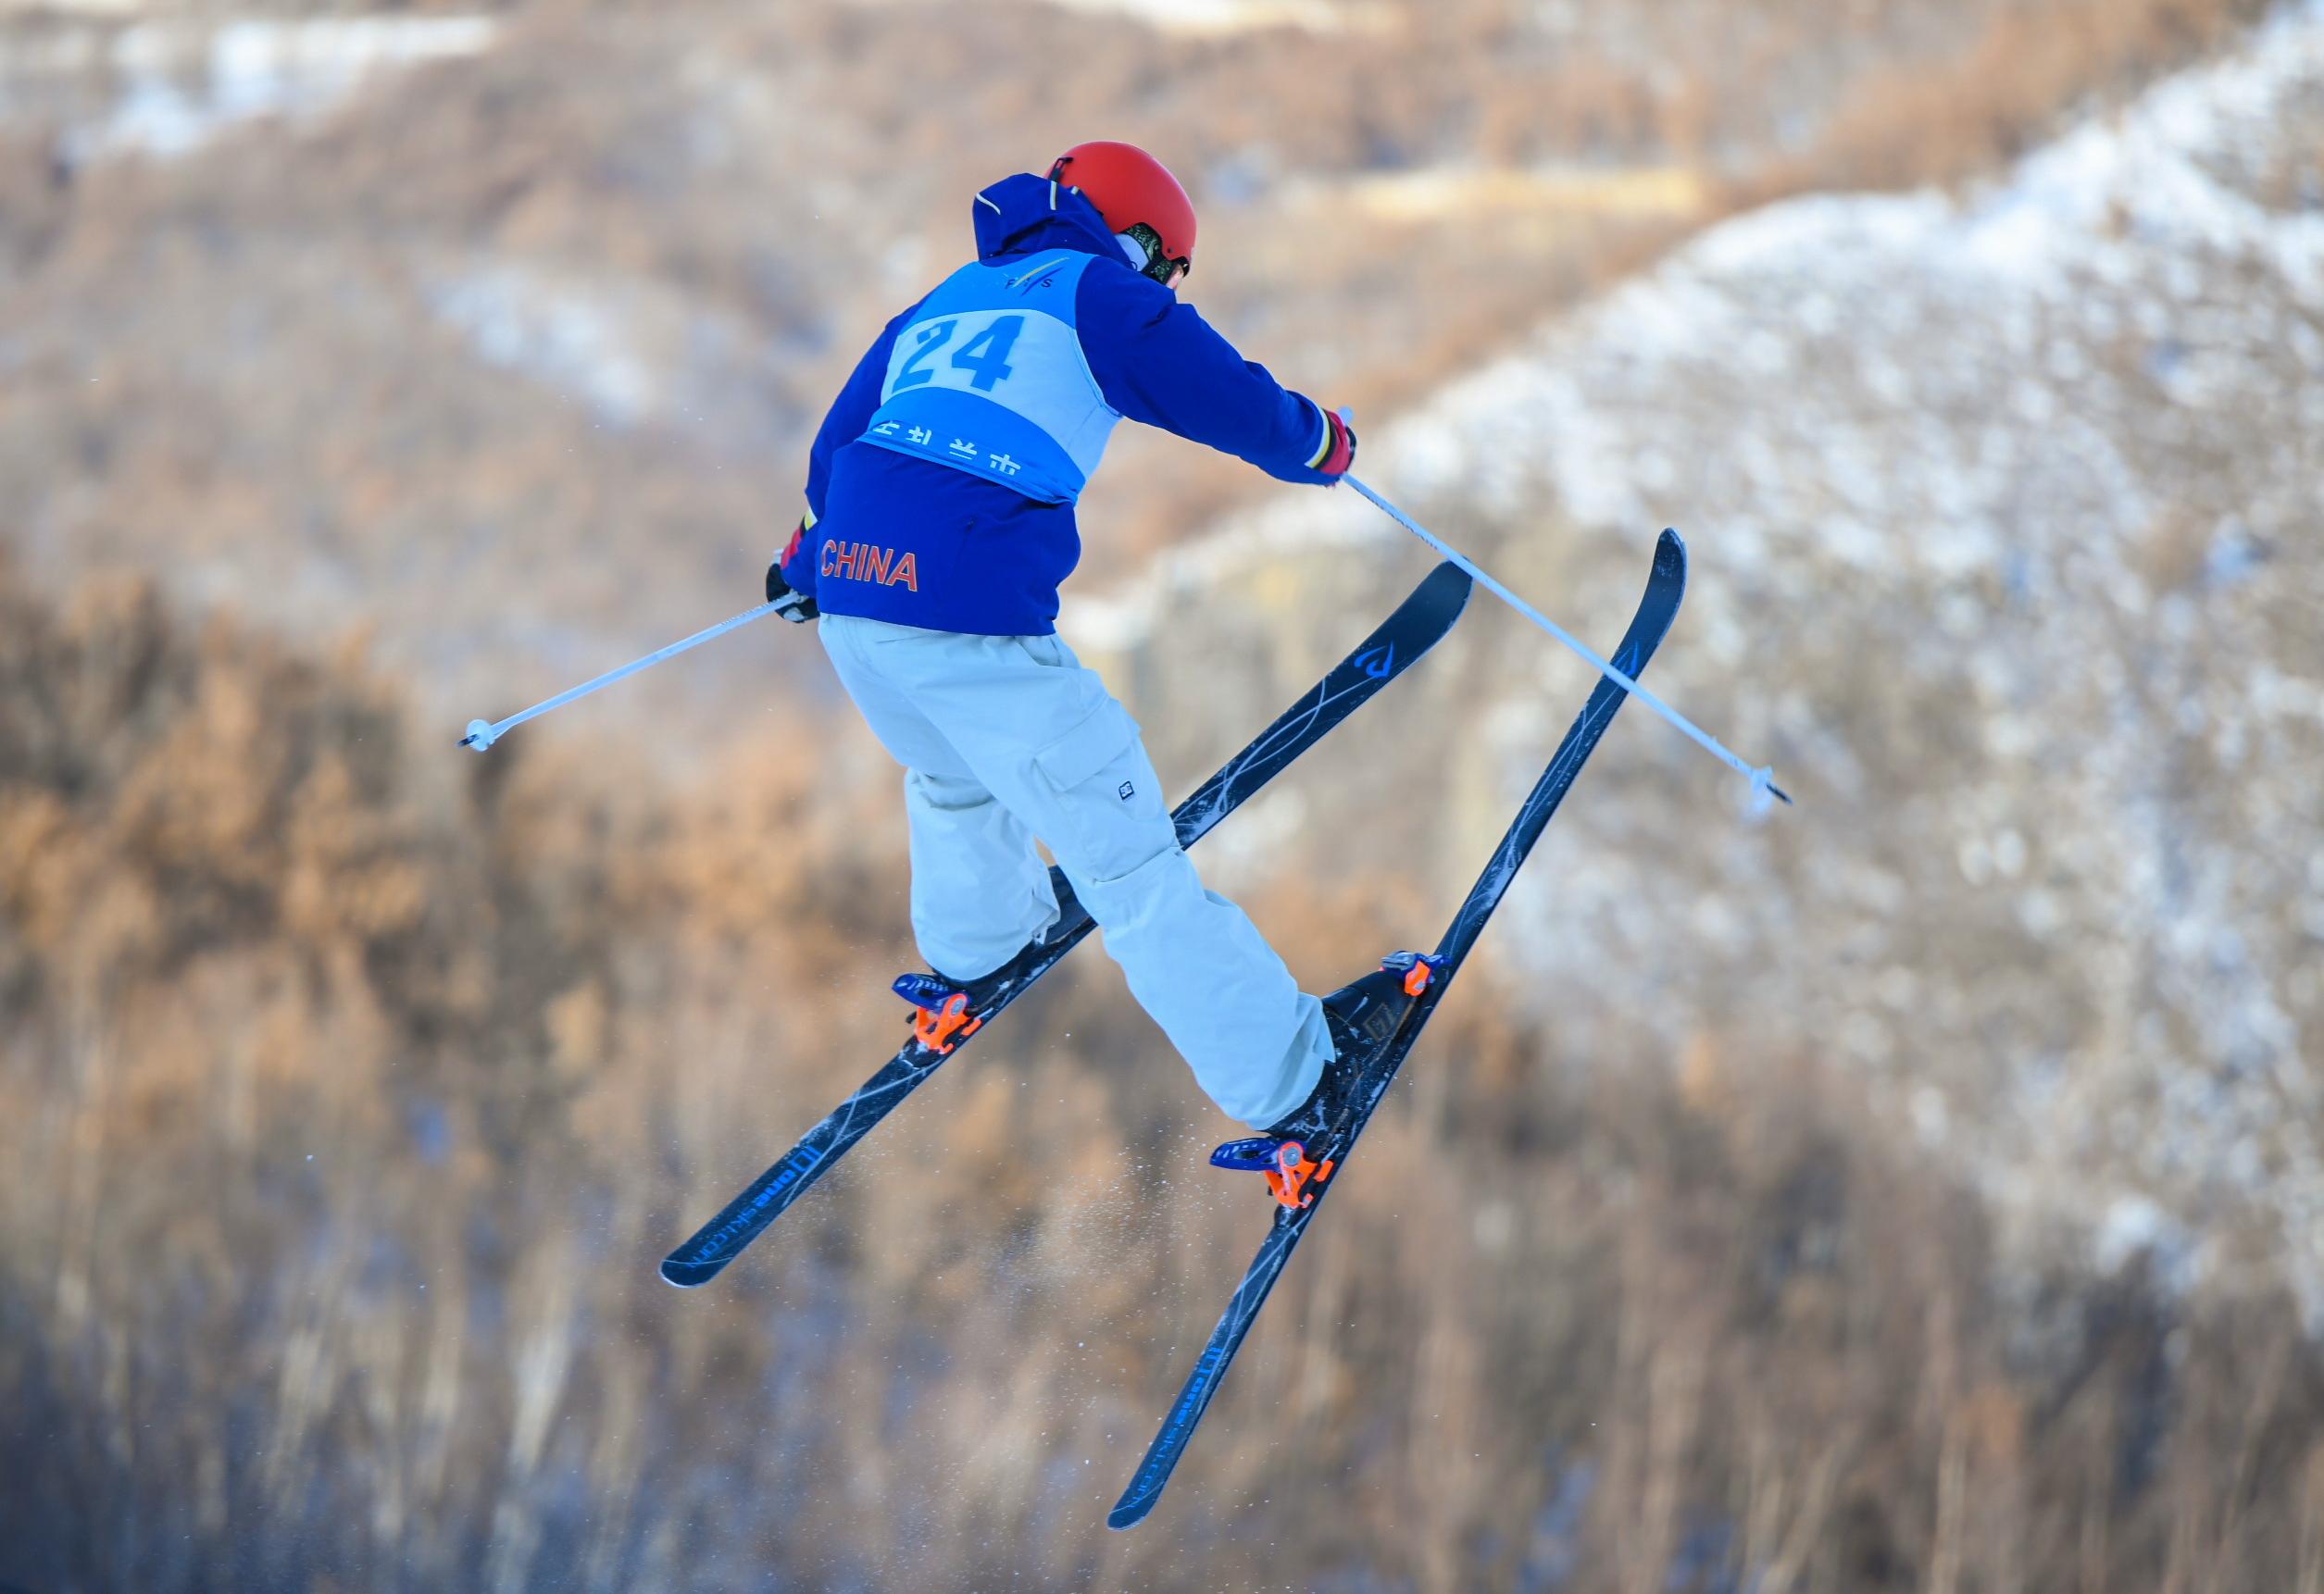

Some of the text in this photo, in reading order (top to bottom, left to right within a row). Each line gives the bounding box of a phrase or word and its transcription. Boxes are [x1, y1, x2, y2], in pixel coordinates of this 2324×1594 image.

[1006, 278, 1053, 290] FIS
[892, 316, 1024, 393] 24
[821, 539, 918, 592] CHINA
